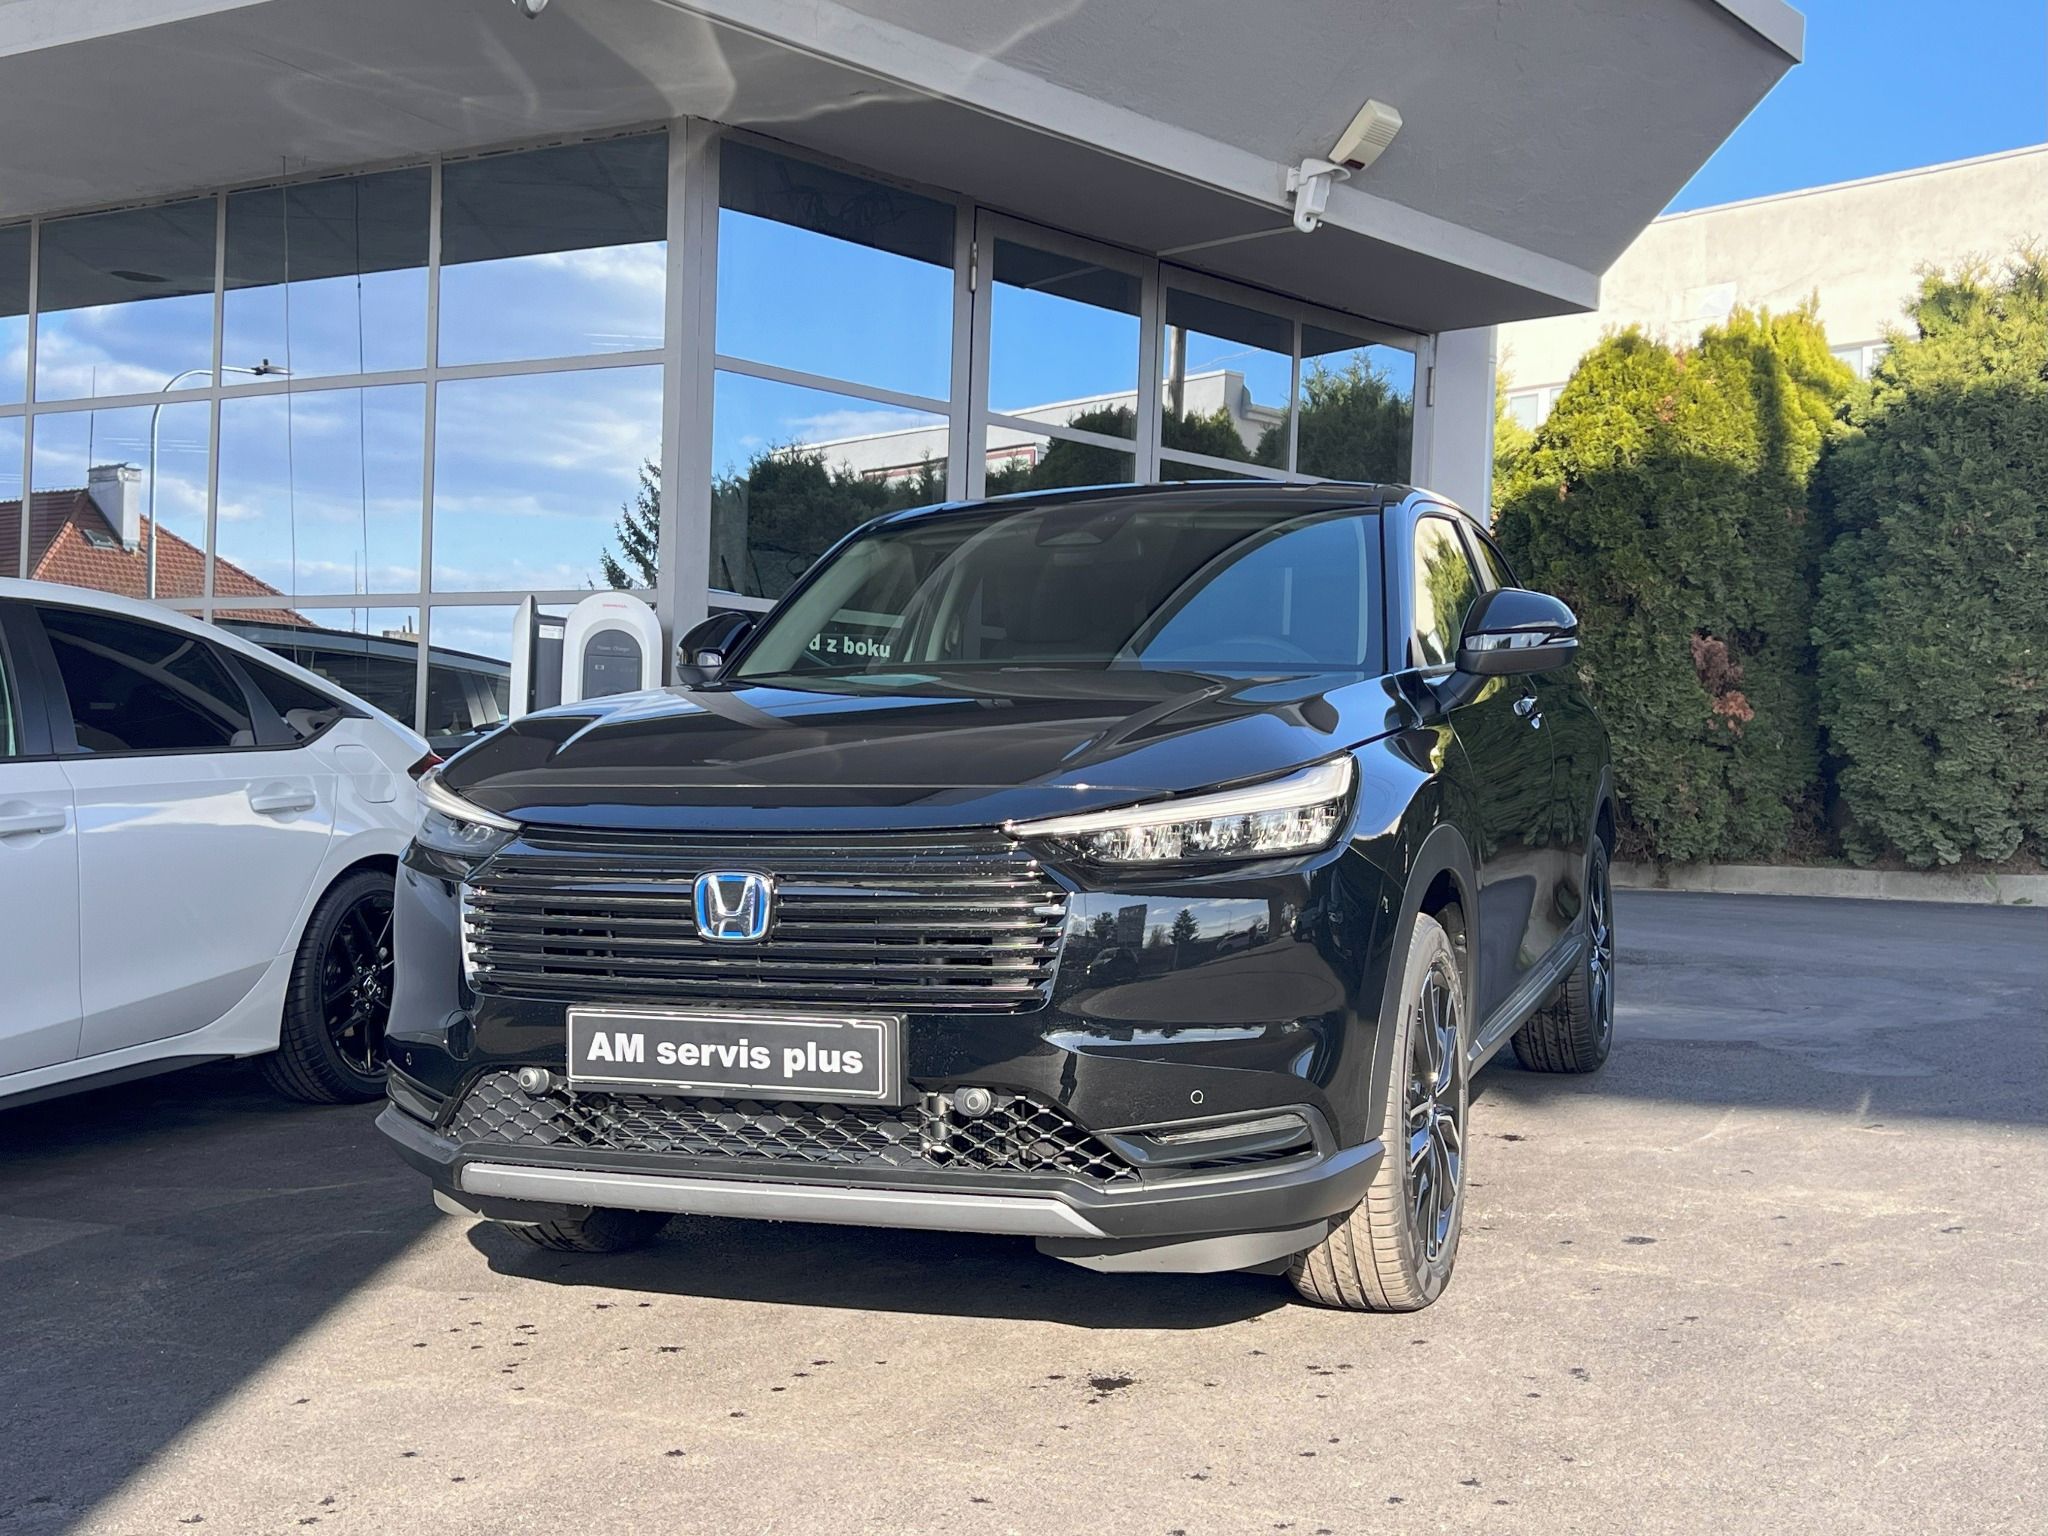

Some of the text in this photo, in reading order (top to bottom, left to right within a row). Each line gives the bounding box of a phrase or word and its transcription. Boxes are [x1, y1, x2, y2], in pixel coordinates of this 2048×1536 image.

[826, 638, 838, 653] z
[843, 635, 892, 659] boku
[586, 1031, 864, 1078] AM servis plus
